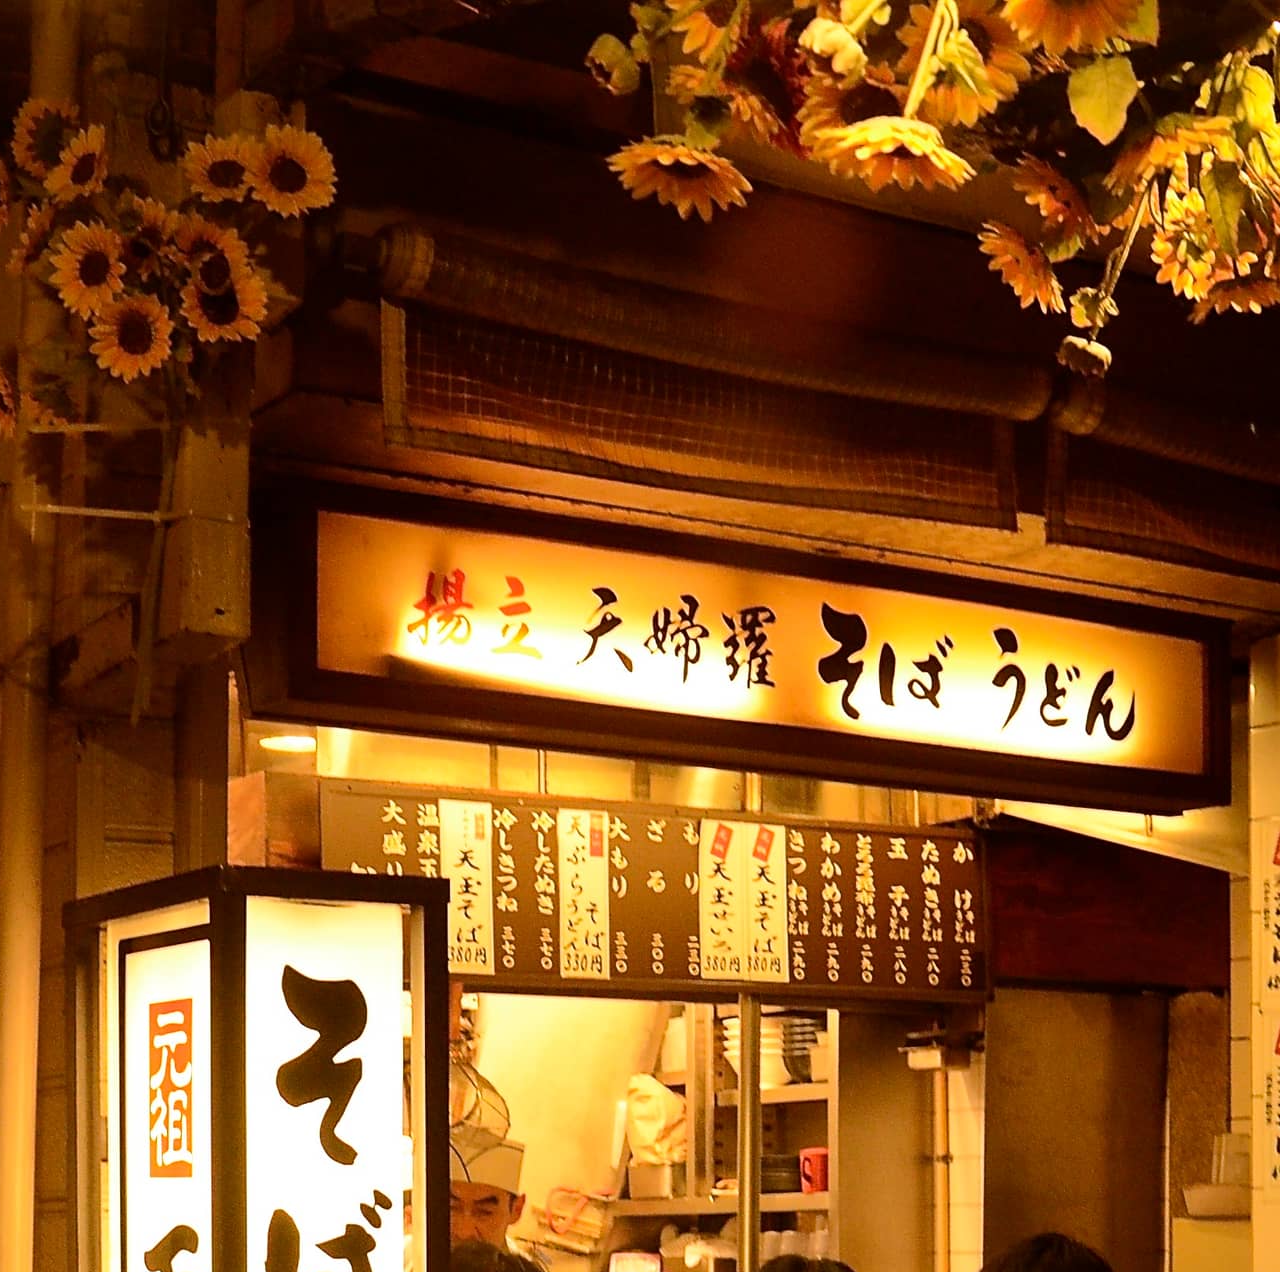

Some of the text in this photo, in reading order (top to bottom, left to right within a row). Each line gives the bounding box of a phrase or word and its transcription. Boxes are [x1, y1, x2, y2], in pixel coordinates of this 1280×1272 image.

[407, 570, 1138, 743] 揚立 天婦羅 そば うどん
[610, 817, 631, 898] 大もり
[647, 819, 667, 893] ざる
[149, 1010, 193, 1167] 元祖
